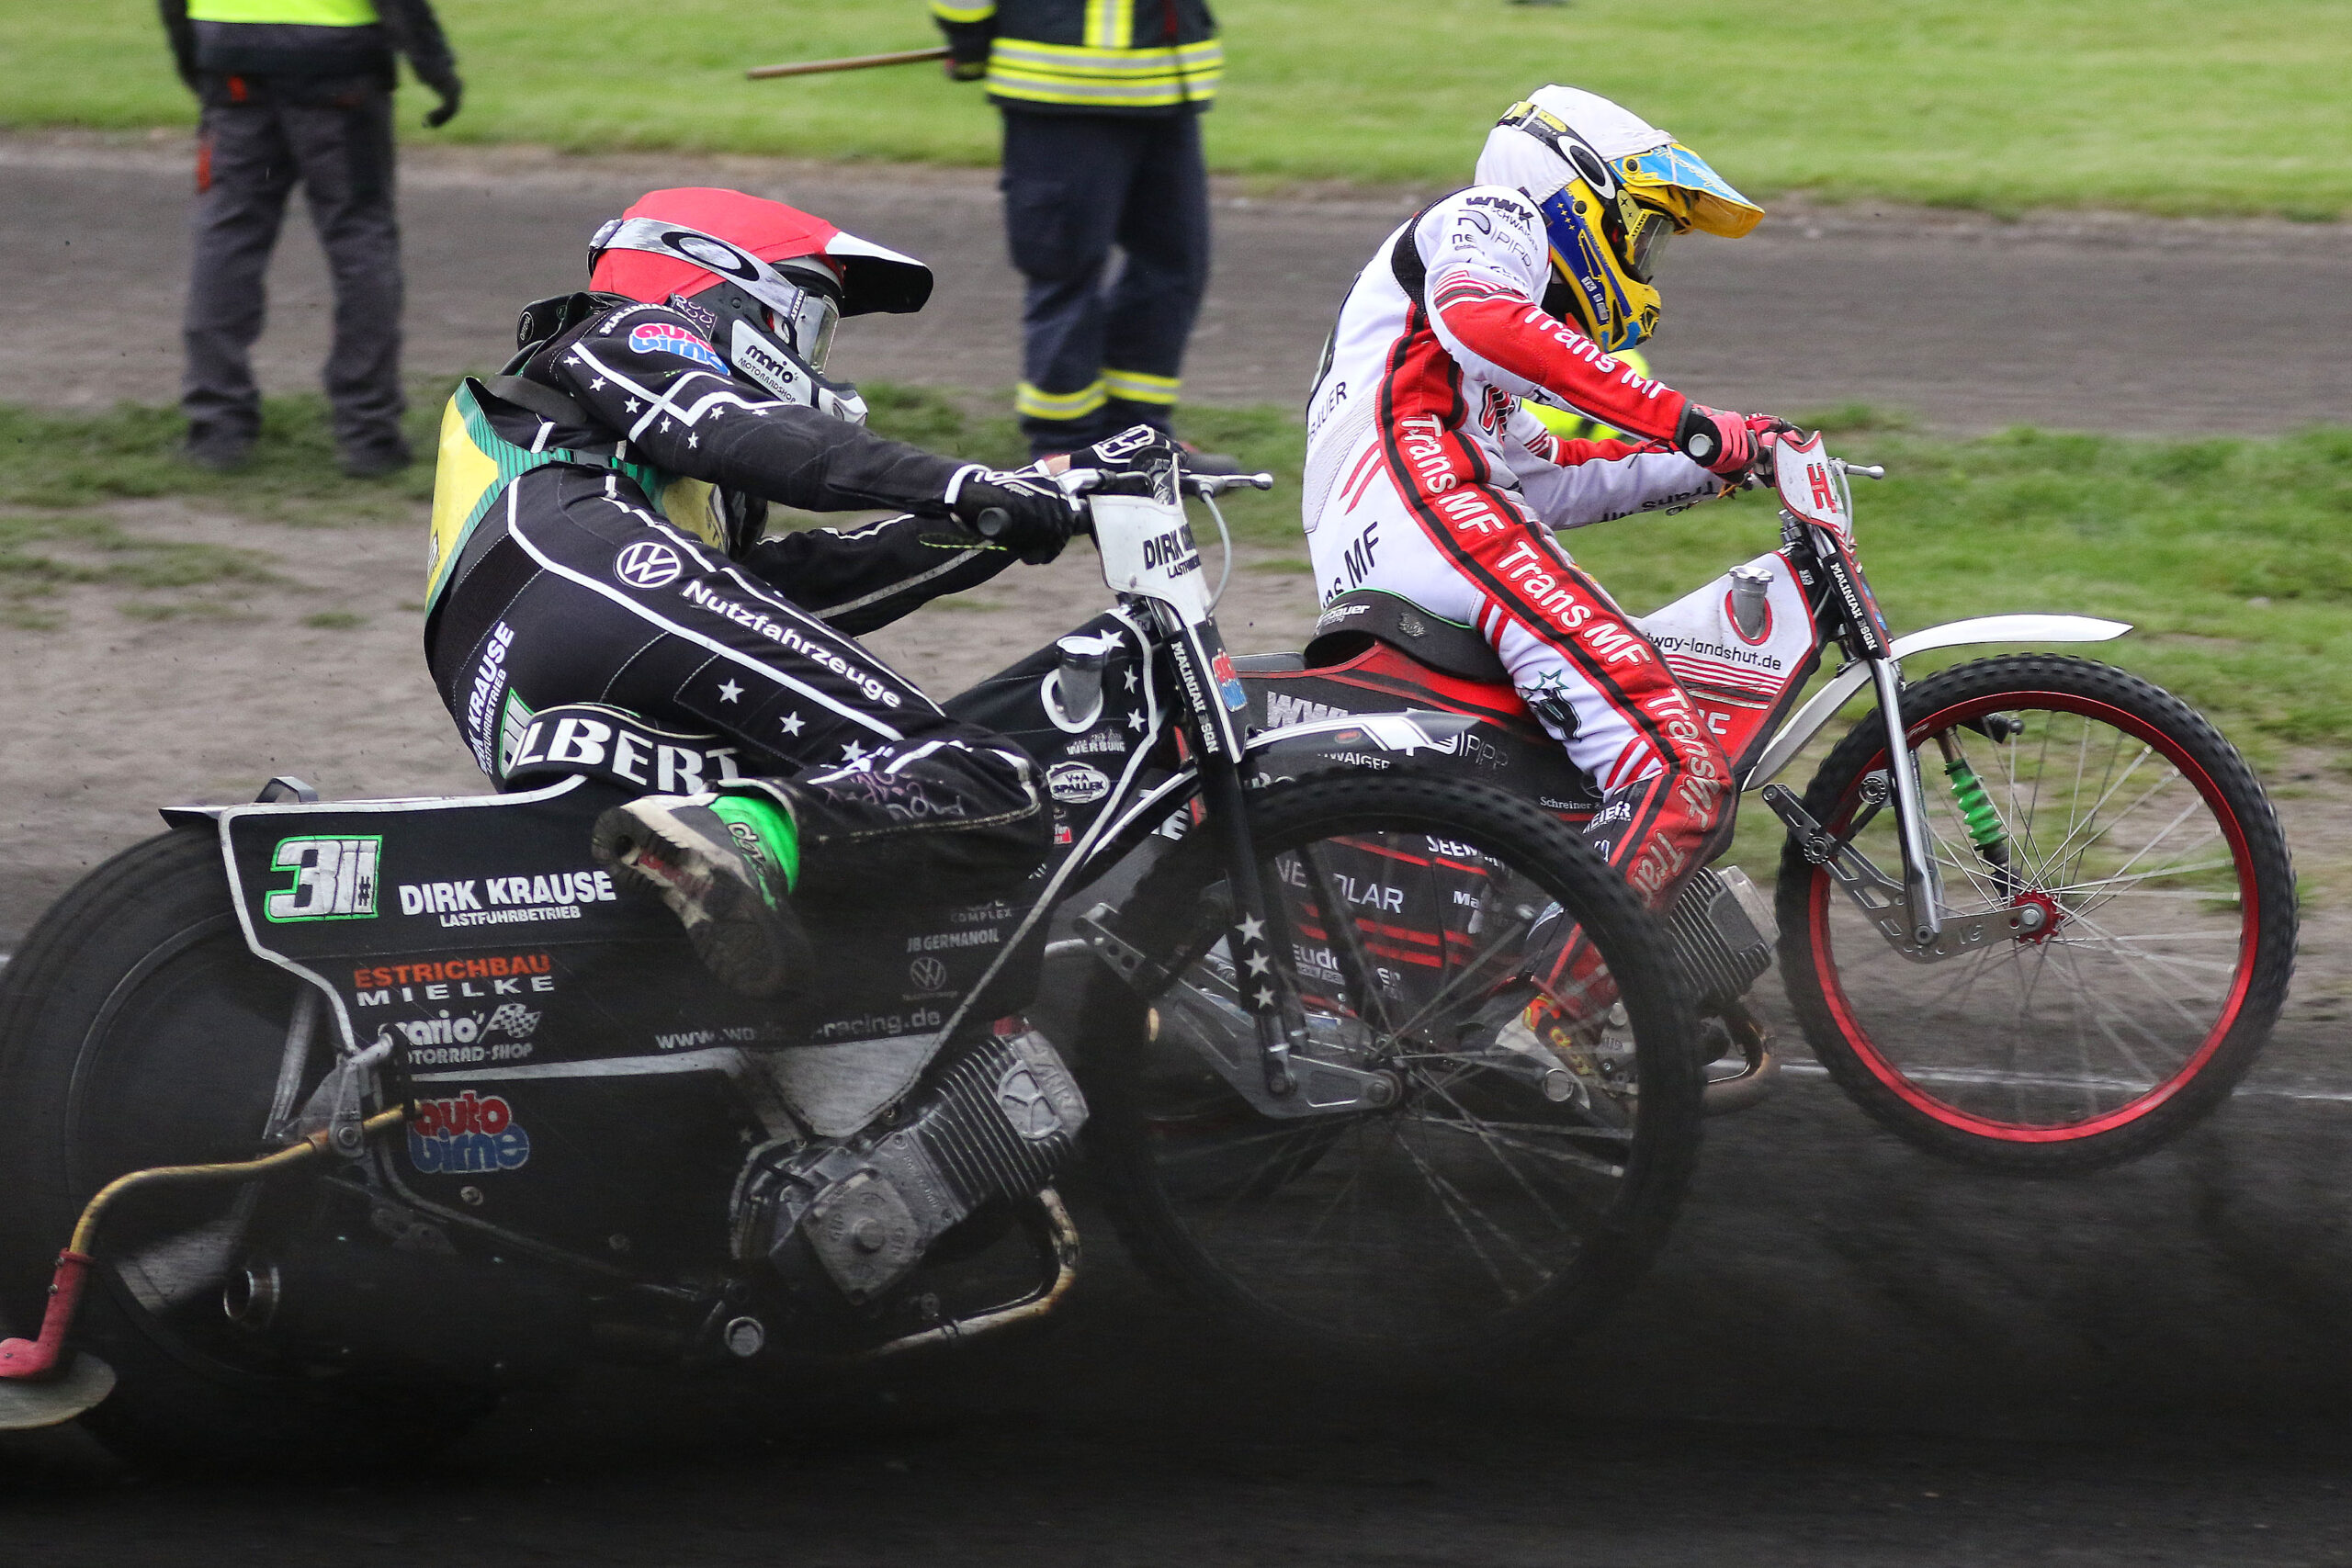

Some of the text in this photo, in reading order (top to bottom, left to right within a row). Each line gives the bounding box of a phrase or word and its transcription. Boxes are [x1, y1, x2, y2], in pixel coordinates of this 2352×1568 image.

[1524, 306, 1619, 373] Trans
[1401, 414, 1506, 534] Trans MF
[1344, 521, 1379, 589] MF
[1498, 541, 1651, 663] Trans MF
[1830, 561, 1864, 619] MALINIAK
[682, 580, 901, 710] Nutzfahrzeuge
[468, 621, 514, 733] KRAUSE
[1170, 641, 1205, 714] MALINIAK
[1540, 796, 1592, 809] Schreiner
[399, 871, 616, 915] DIRK KRAUSE
[440, 905, 582, 928] LASTFUHRBETRIEB
[355, 954, 550, 987] ESTRICHBAU
[356, 976, 555, 1006] MIELKE
[407, 1043, 533, 1066] TORRAD-SHOP
[413, 1090, 512, 1137] auto
